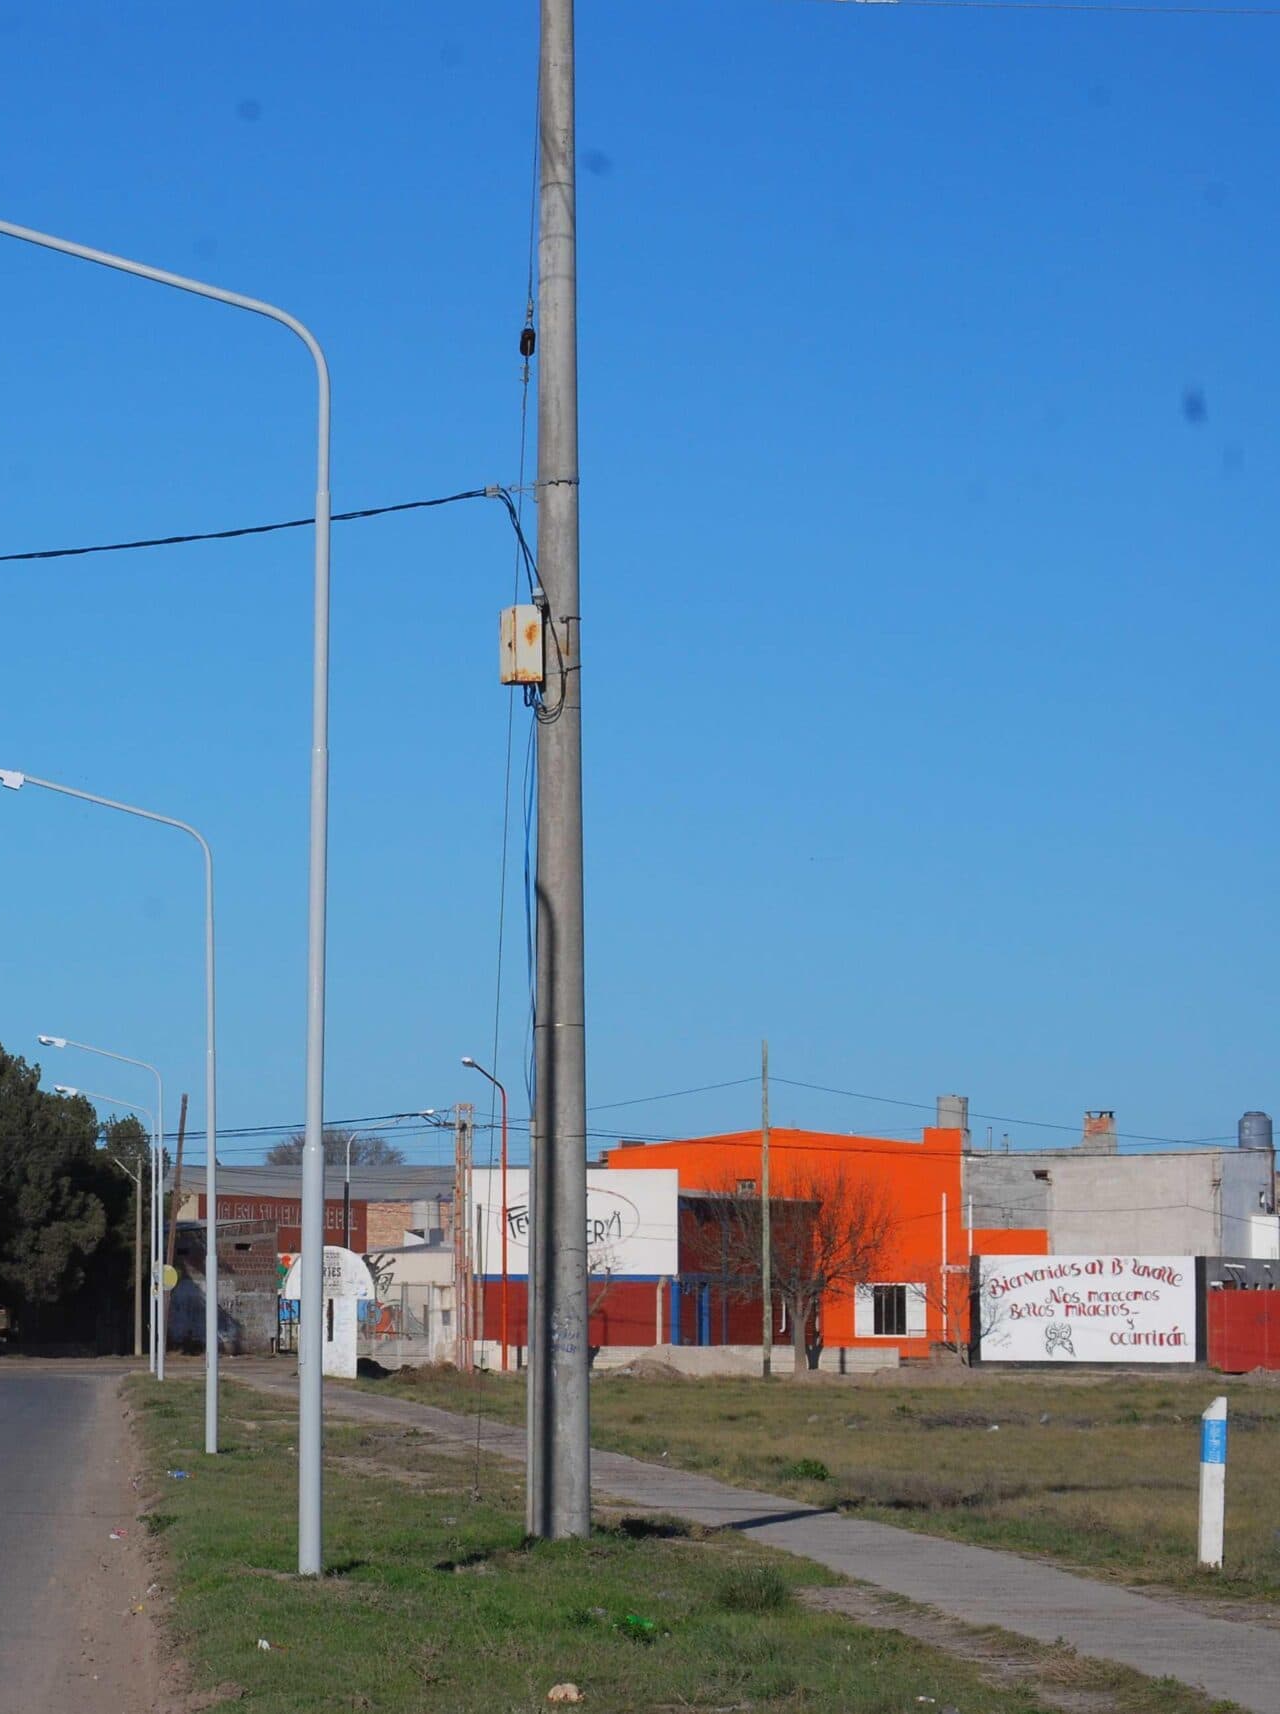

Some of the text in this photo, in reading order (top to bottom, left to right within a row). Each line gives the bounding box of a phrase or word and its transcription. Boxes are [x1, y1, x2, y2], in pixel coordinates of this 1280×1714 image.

[988, 1262, 1082, 1299] Bienvenidos
[1084, 1259, 1104, 1275] al
[1045, 1286, 1081, 1304] Nos
[1109, 1326, 1188, 1346] ocurrirán
